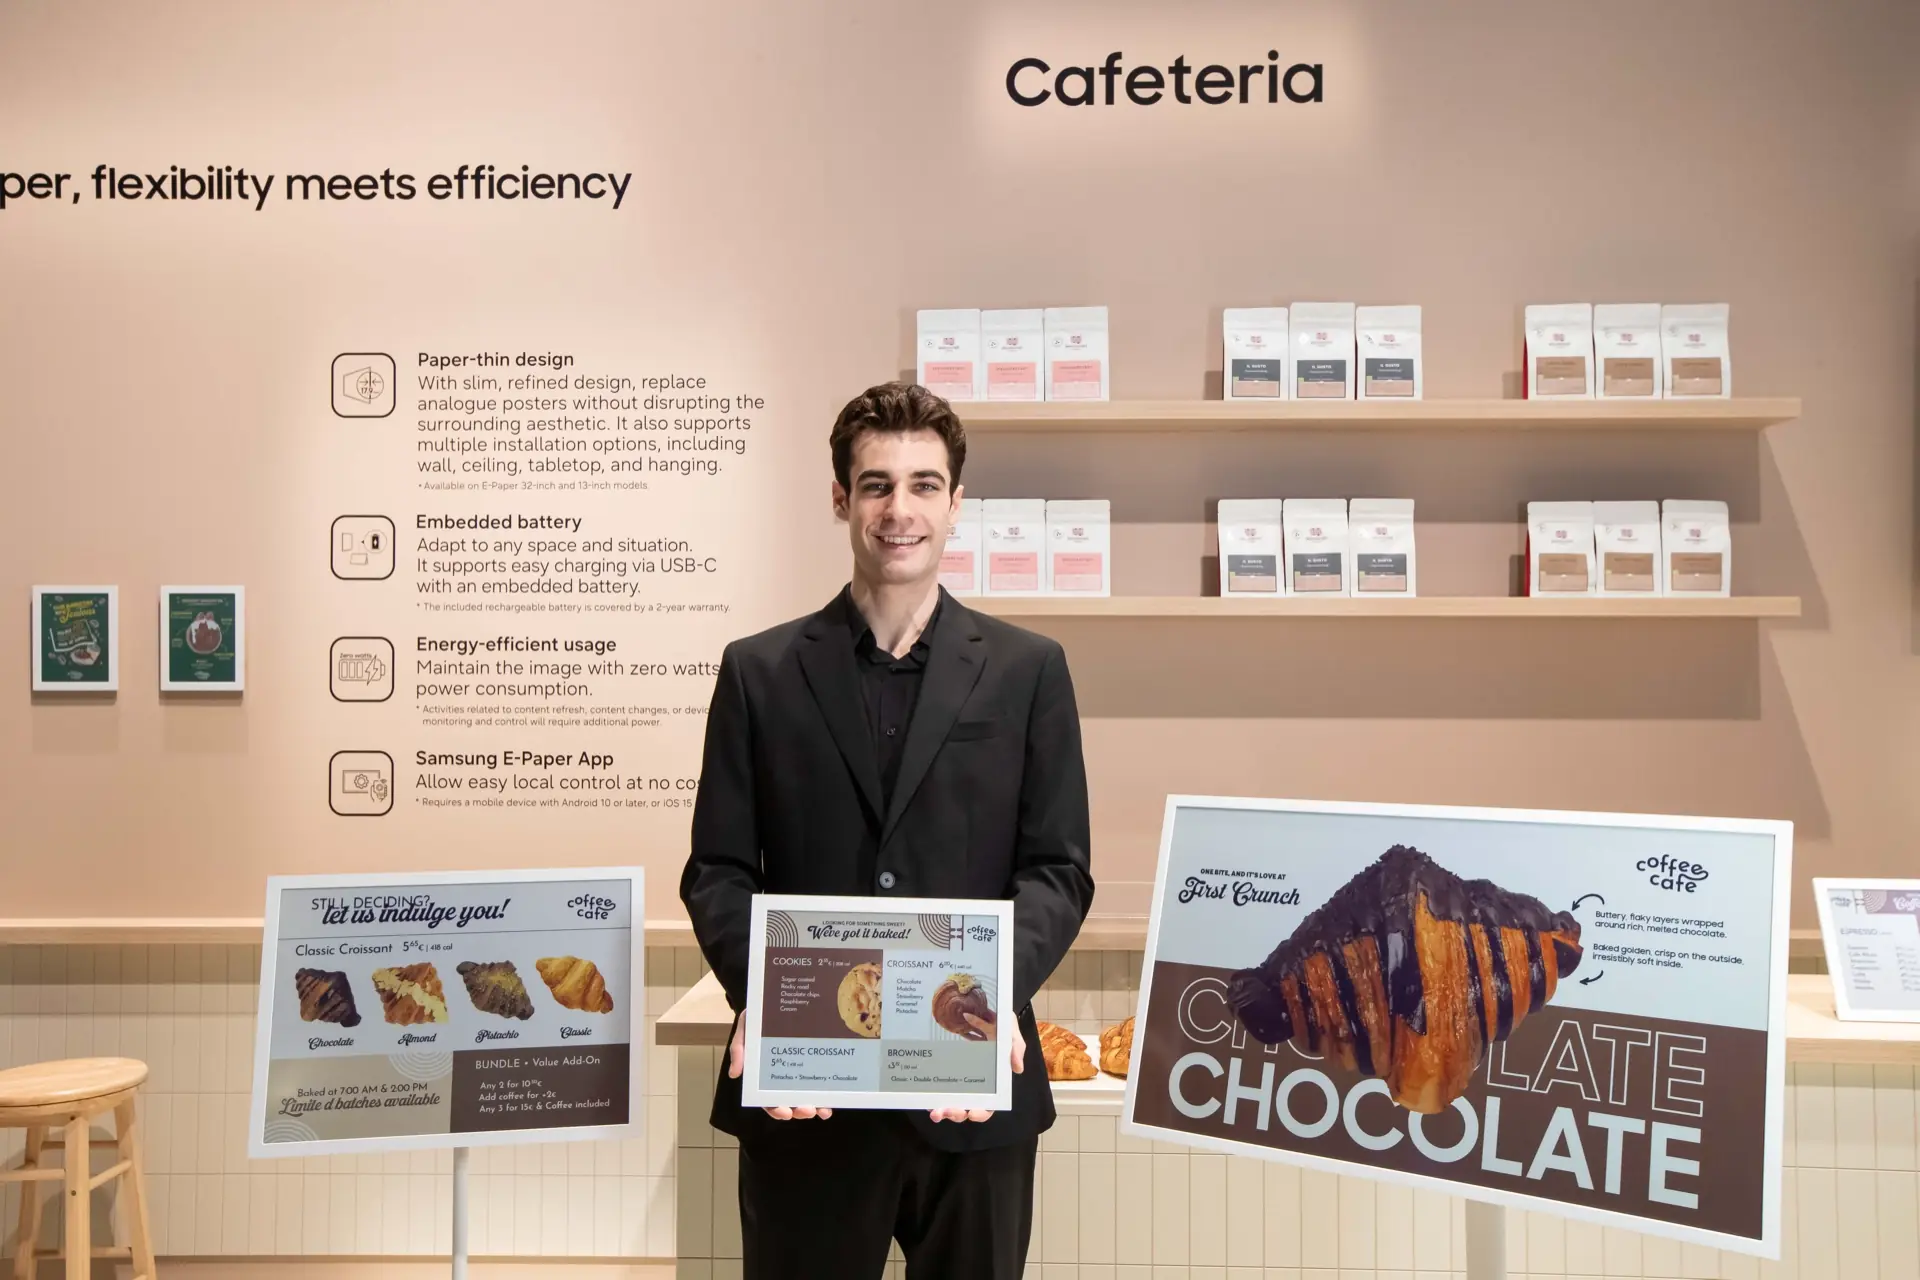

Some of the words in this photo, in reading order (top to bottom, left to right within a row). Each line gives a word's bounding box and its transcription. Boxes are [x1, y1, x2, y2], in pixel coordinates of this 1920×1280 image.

[1005, 49, 1324, 107] Cafeteria
[0, 172, 81, 210] per,
[90, 163, 275, 212] flexibility
[286, 167, 417, 201] meets
[426, 164, 633, 210] efficiency
[418, 351, 510, 370] Paper-thin
[515, 351, 574, 370] design
[417, 374, 458, 391] With
[462, 374, 502, 393] slim,
[508, 374, 569, 391] refined
[573, 374, 636, 394] design,
[641, 374, 707, 394] replace
[417, 395, 497, 414] analogue
[502, 396, 568, 414] posters
[572, 394, 639, 411] without
[643, 394, 731, 414] disrupting
[735, 394, 765, 410] the
[417, 415, 521, 435] surrounding
[526, 415, 611, 432] aesthetic.
[616, 415, 629, 431] It
[633, 415, 669, 431] also
[673, 415, 751, 435] supports
[417, 435, 488, 456] multiple
[493, 435, 587, 452] installation
[592, 435, 661, 456] options,
[667, 435, 746, 456] including
[416, 456, 456, 475] wall,
[461, 456, 523, 476] ceiling,
[527, 456, 605, 476] tabletop,
[610, 456, 643, 473] and
[648, 456, 723, 476] hanging.
[416, 513, 513, 530] Embedded
[517, 513, 583, 532] battery
[416, 536, 467, 557] Adapt
[471, 538, 489, 553] to
[493, 540, 524, 557] any
[527, 540, 577, 557] space
[581, 536, 613, 553] and
[617, 536, 693, 553] situation.
[417, 557, 429, 573] It
[432, 558, 507, 577] supports
[511, 560, 550, 578] easy
[554, 557, 627, 578] charging
[631, 557, 656, 573] via
[660, 557, 717, 574] USB-C
[416, 578, 452, 594] with
[456, 581, 477, 594] an
[481, 578, 573, 594] embedded
[578, 578, 641, 598] battery.
[423, 601, 441, 612] The
[442, 601, 483, 612] included
[484, 601, 547, 615] rechargeable
[548, 601, 583, 615] battery
[584, 603, 593, 613] is
[593, 601, 632, 613] covered
[633, 601, 646, 614] by
[647, 603, 654, 612] a
[655, 602, 687, 615] 2-year
[687, 603, 731, 614] warranty.
[416, 635, 559, 656] Energy-efficient
[563, 639, 617, 656] usage
[416, 659, 490, 676] Maintain
[495, 659, 524, 676] the
[529, 659, 583, 680] image
[587, 659, 624, 676] with
[629, 663, 668, 676] zero
[672, 661, 720, 677] watts
[416, 683, 471, 700] power
[475, 680, 593, 701] consumption.
[415, 749, 498, 770] Samsung
[503, 750, 574, 770] E-Paper
[577, 750, 614, 770] App
[415, 773, 464, 790] Allow
[467, 777, 508, 794] easy
[513, 773, 555, 790] local
[559, 773, 622, 791] control
[626, 775, 644, 791] at
[648, 778, 671, 791] no
[1636, 854, 1709, 881] coffee
[1179, 876, 1228, 903] First
[1232, 881, 1300, 907] Crunch
[312, 897, 345, 910] STILL
[353, 895, 430, 909] DECIDING?
[567, 894, 616, 911] coffee
[322, 900, 350, 925] let
[351, 909, 376, 923] us
[379, 900, 457, 929] indulge
[457, 898, 511, 928] you!
[1630, 912, 1651, 923] flaky
[1653, 915, 1679, 926] layers
[1682, 918, 1724, 929] wrapped
[841, 928, 860, 941] got
[863, 928, 870, 938] it
[872, 928, 912, 939] baked!
[967, 925, 996, 936] coffee
[1595, 921, 1626, 930] around
[1647, 924, 1678, 934] melted
[1680, 927, 1727, 939] chocolate.
[295, 944, 335, 956] Classic
[339, 943, 393, 955] Croissant
[1593, 943, 1620, 952] Baked
[1655, 948, 1676, 960] crisp
[1678, 951, 1689, 959] on
[1692, 951, 1706, 961] the
[773, 957, 812, 966] COOKIES
[887, 960, 934, 968] CROISSANT
[1592, 952, 1635, 965] irresistibly
[1637, 956, 1654, 966] soft
[1656, 959, 1683, 968] inside.
[398, 1033, 437, 1046] Almond
[475, 1029, 519, 1043] Pistachio
[560, 1026, 592, 1039] Classic
[308, 1037, 354, 1050] Chocolate
[771, 1047, 805, 1055] CLASSIC
[808, 1048, 855, 1056] CROISSANT
[887, 1049, 933, 1057] BROWNIES
[1178, 977, 1707, 1118] CLATE
[475, 1058, 520, 1070] BUNDLE
[532, 1057, 558, 1067] Value
[562, 1055, 601, 1066] Add-On
[335, 1096, 382, 1110] batches
[384, 1093, 440, 1107] available
[479, 1105, 496, 1114] Any
[498, 1104, 503, 1112] 3
[506, 1103, 518, 1111] for
[546, 1101, 573, 1110] Coffee
[575, 1099, 610, 1108] included
[1168, 1052, 1702, 1210] CHOCOLATE
